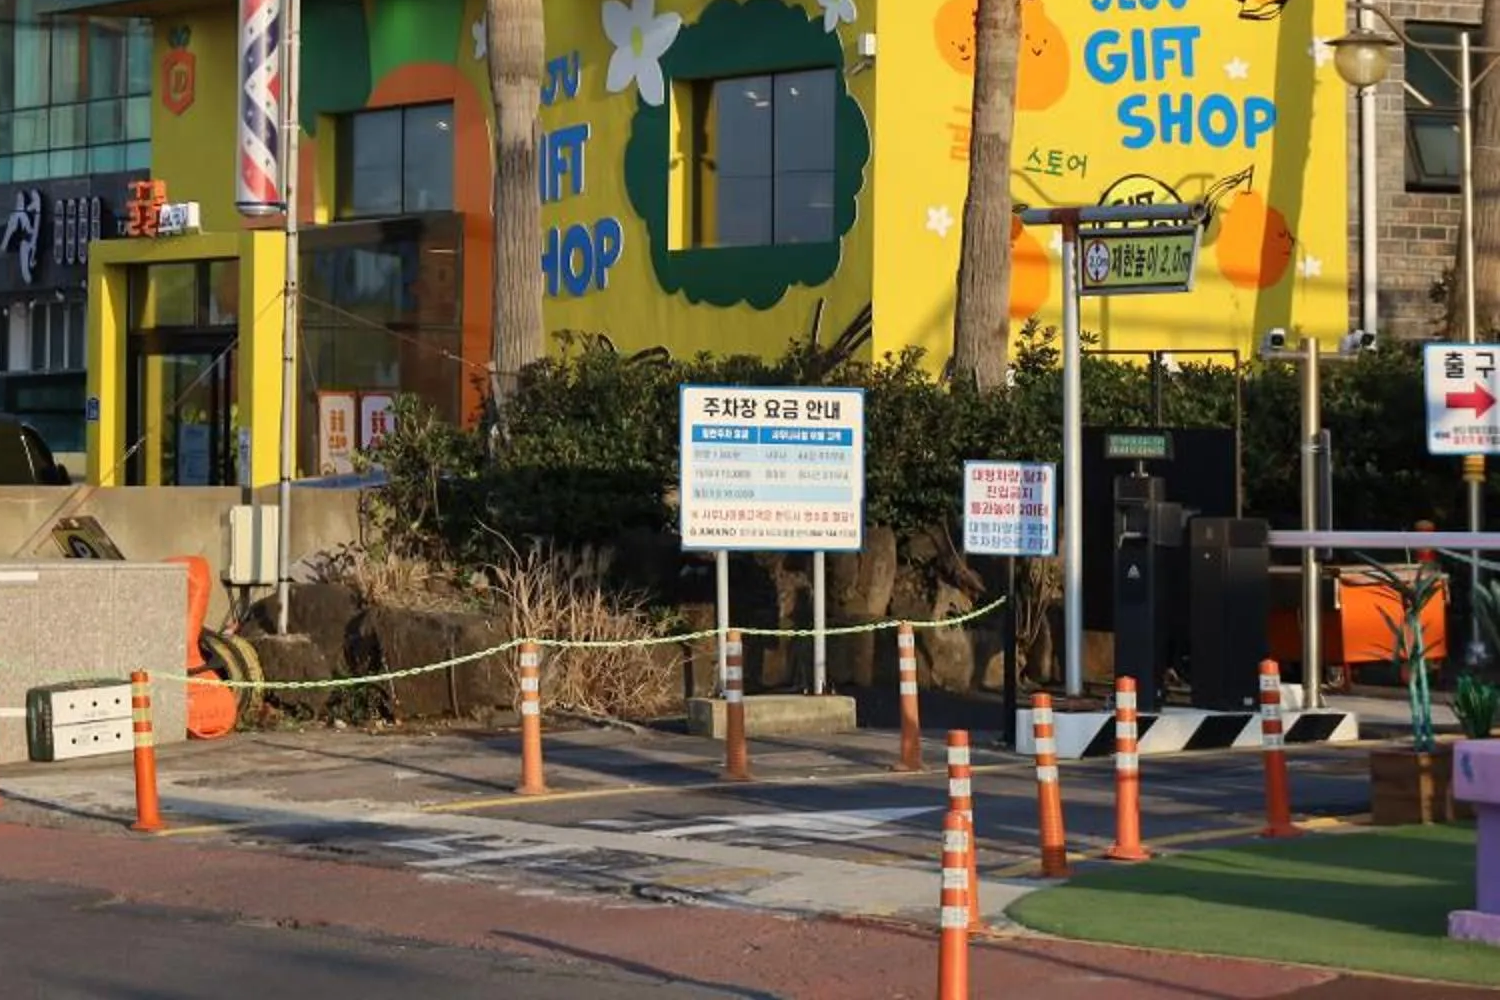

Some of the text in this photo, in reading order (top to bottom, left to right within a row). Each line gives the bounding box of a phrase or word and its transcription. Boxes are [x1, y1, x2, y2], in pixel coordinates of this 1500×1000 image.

[540, 49, 580, 104] JU
[1084, 25, 1201, 85] GIFT
[1117, 92, 1277, 149] SHOP
[540, 123, 590, 204] IFT
[1023, 146, 1088, 179] 스토어
[541, 217, 624, 298] HOP
[1111, 243, 1159, 278] 제한높이
[1445, 351, 1496, 379] 출구
[703, 397, 841, 421] 주차장 요금 안내
